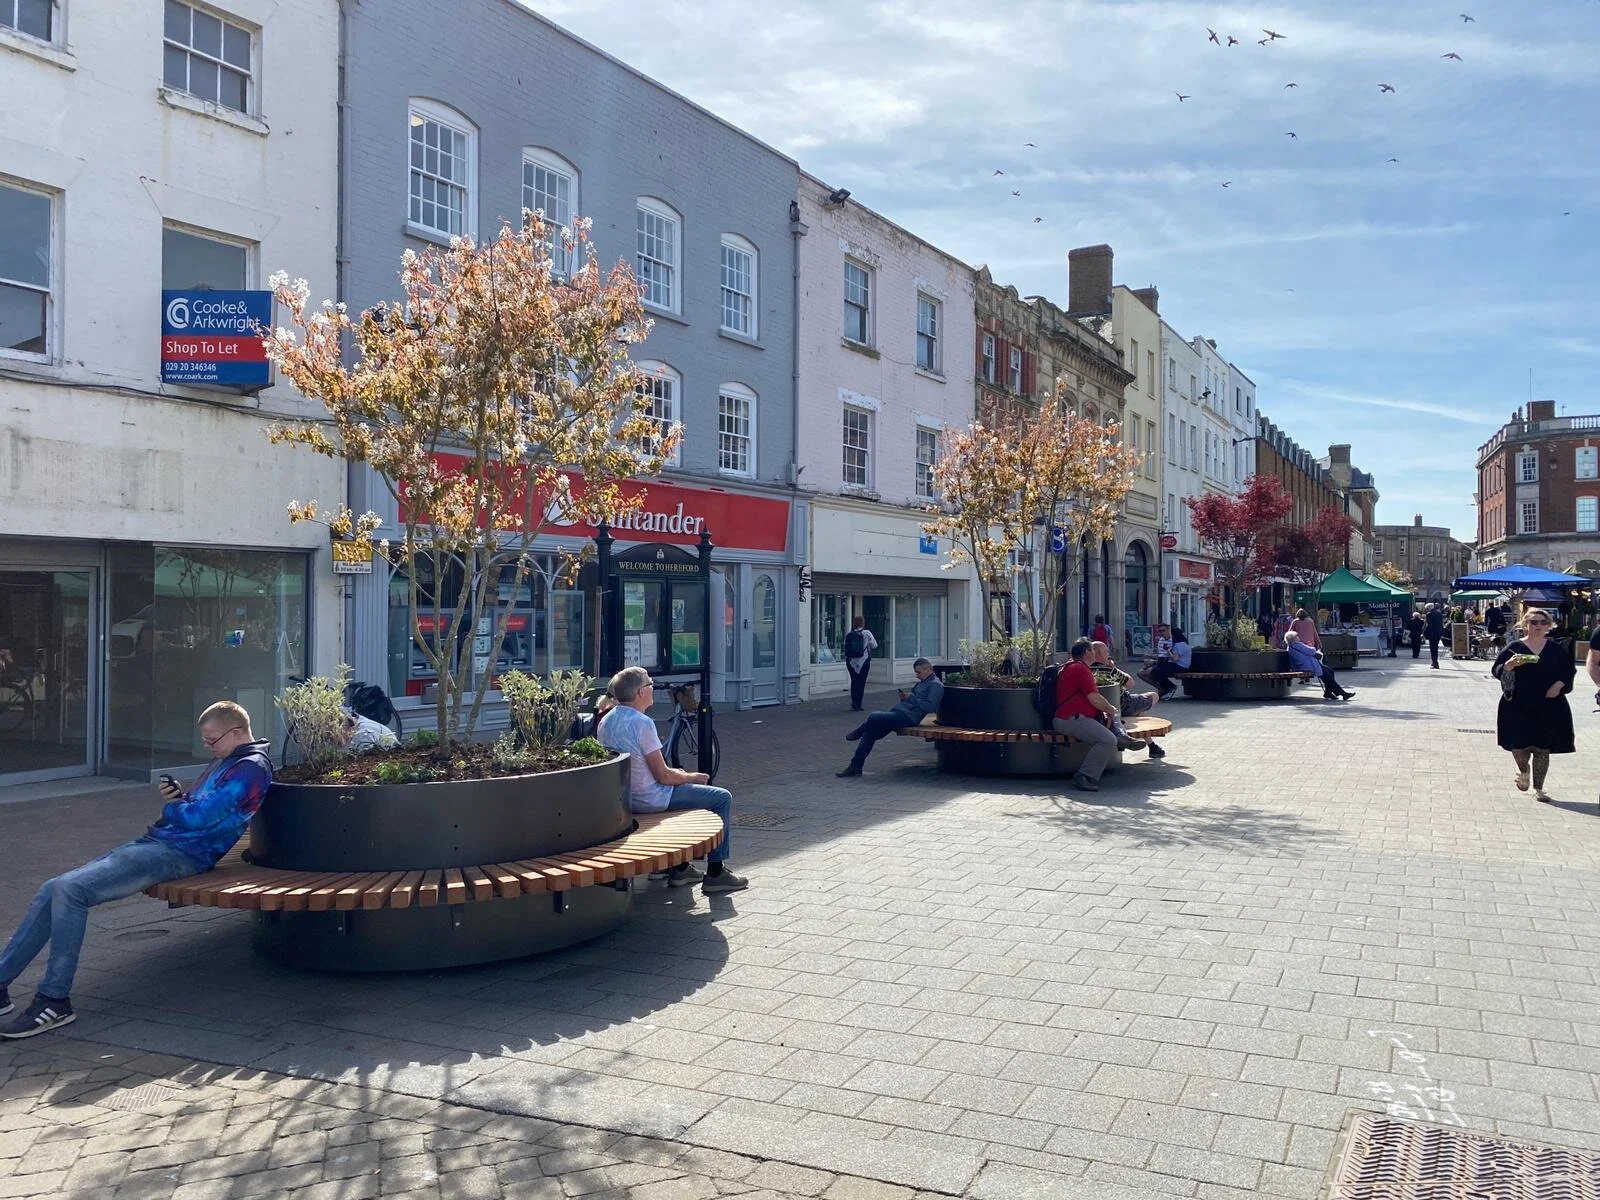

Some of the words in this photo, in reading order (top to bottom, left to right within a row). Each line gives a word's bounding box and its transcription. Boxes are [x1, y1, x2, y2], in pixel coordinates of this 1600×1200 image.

[192, 299, 248, 315] Cooke&
[192, 315, 261, 332] Arkwright
[166, 341, 198, 356] Shop
[200, 341, 215, 354] To
[218, 341, 239, 354] Let
[165, 362, 179, 371] 029
[180, 362, 189, 371] 20
[190, 362, 217, 372] 346346
[586, 502, 705, 535] Sntander
[619, 561, 654, 571] WELCOME
[655, 563, 665, 571] TO
[665, 563, 700, 572] HEREFORD
